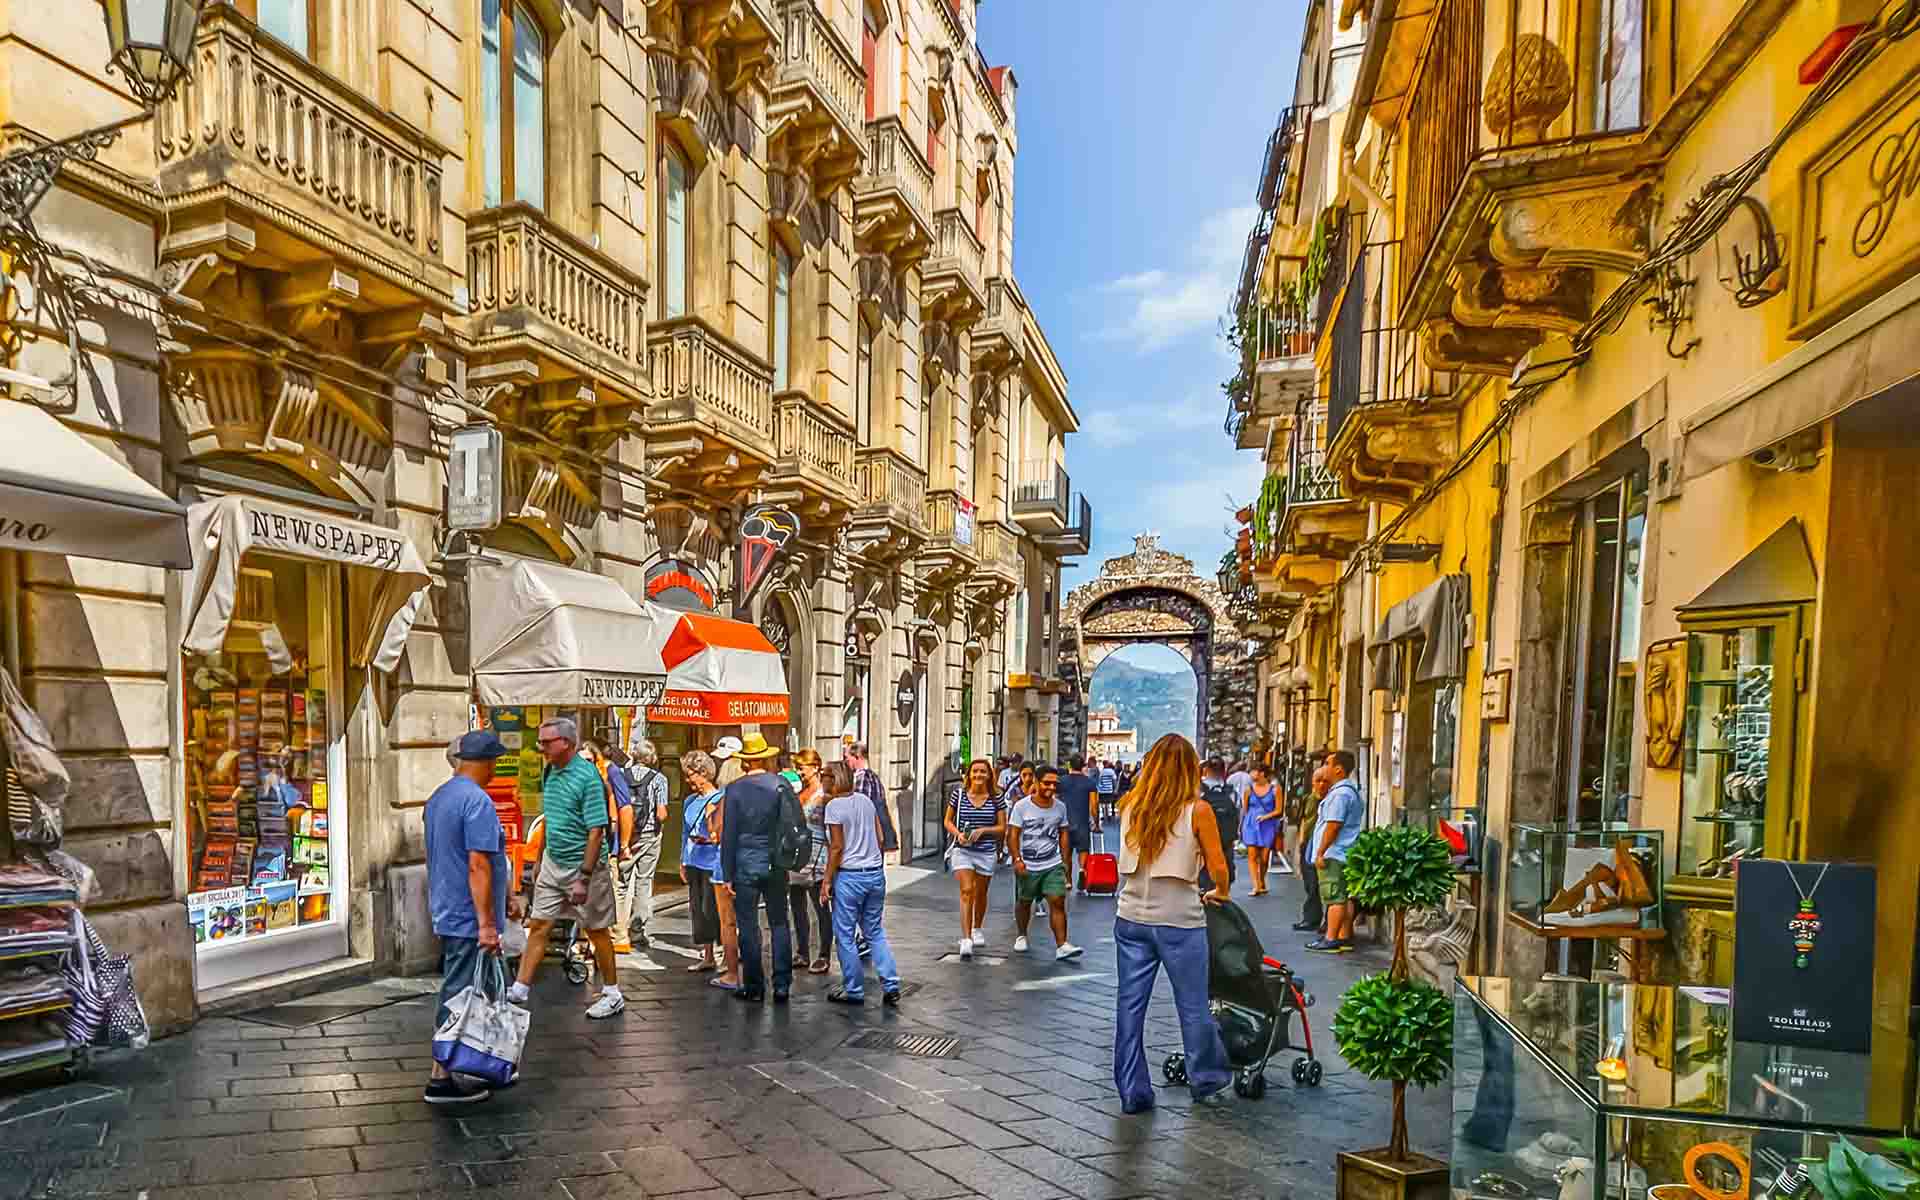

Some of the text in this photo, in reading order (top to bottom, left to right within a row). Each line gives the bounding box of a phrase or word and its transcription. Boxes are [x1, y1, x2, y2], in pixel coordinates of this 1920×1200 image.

[454, 432, 488, 496] T
[250, 510, 401, 563] NEWSPAPER
[664, 696, 700, 707] GELATO
[727, 700, 786, 717] GELATOMANIA
[652, 706, 710, 719] ARTIGIANALE
[1768, 1016, 1832, 1029] TROLLBEADS
